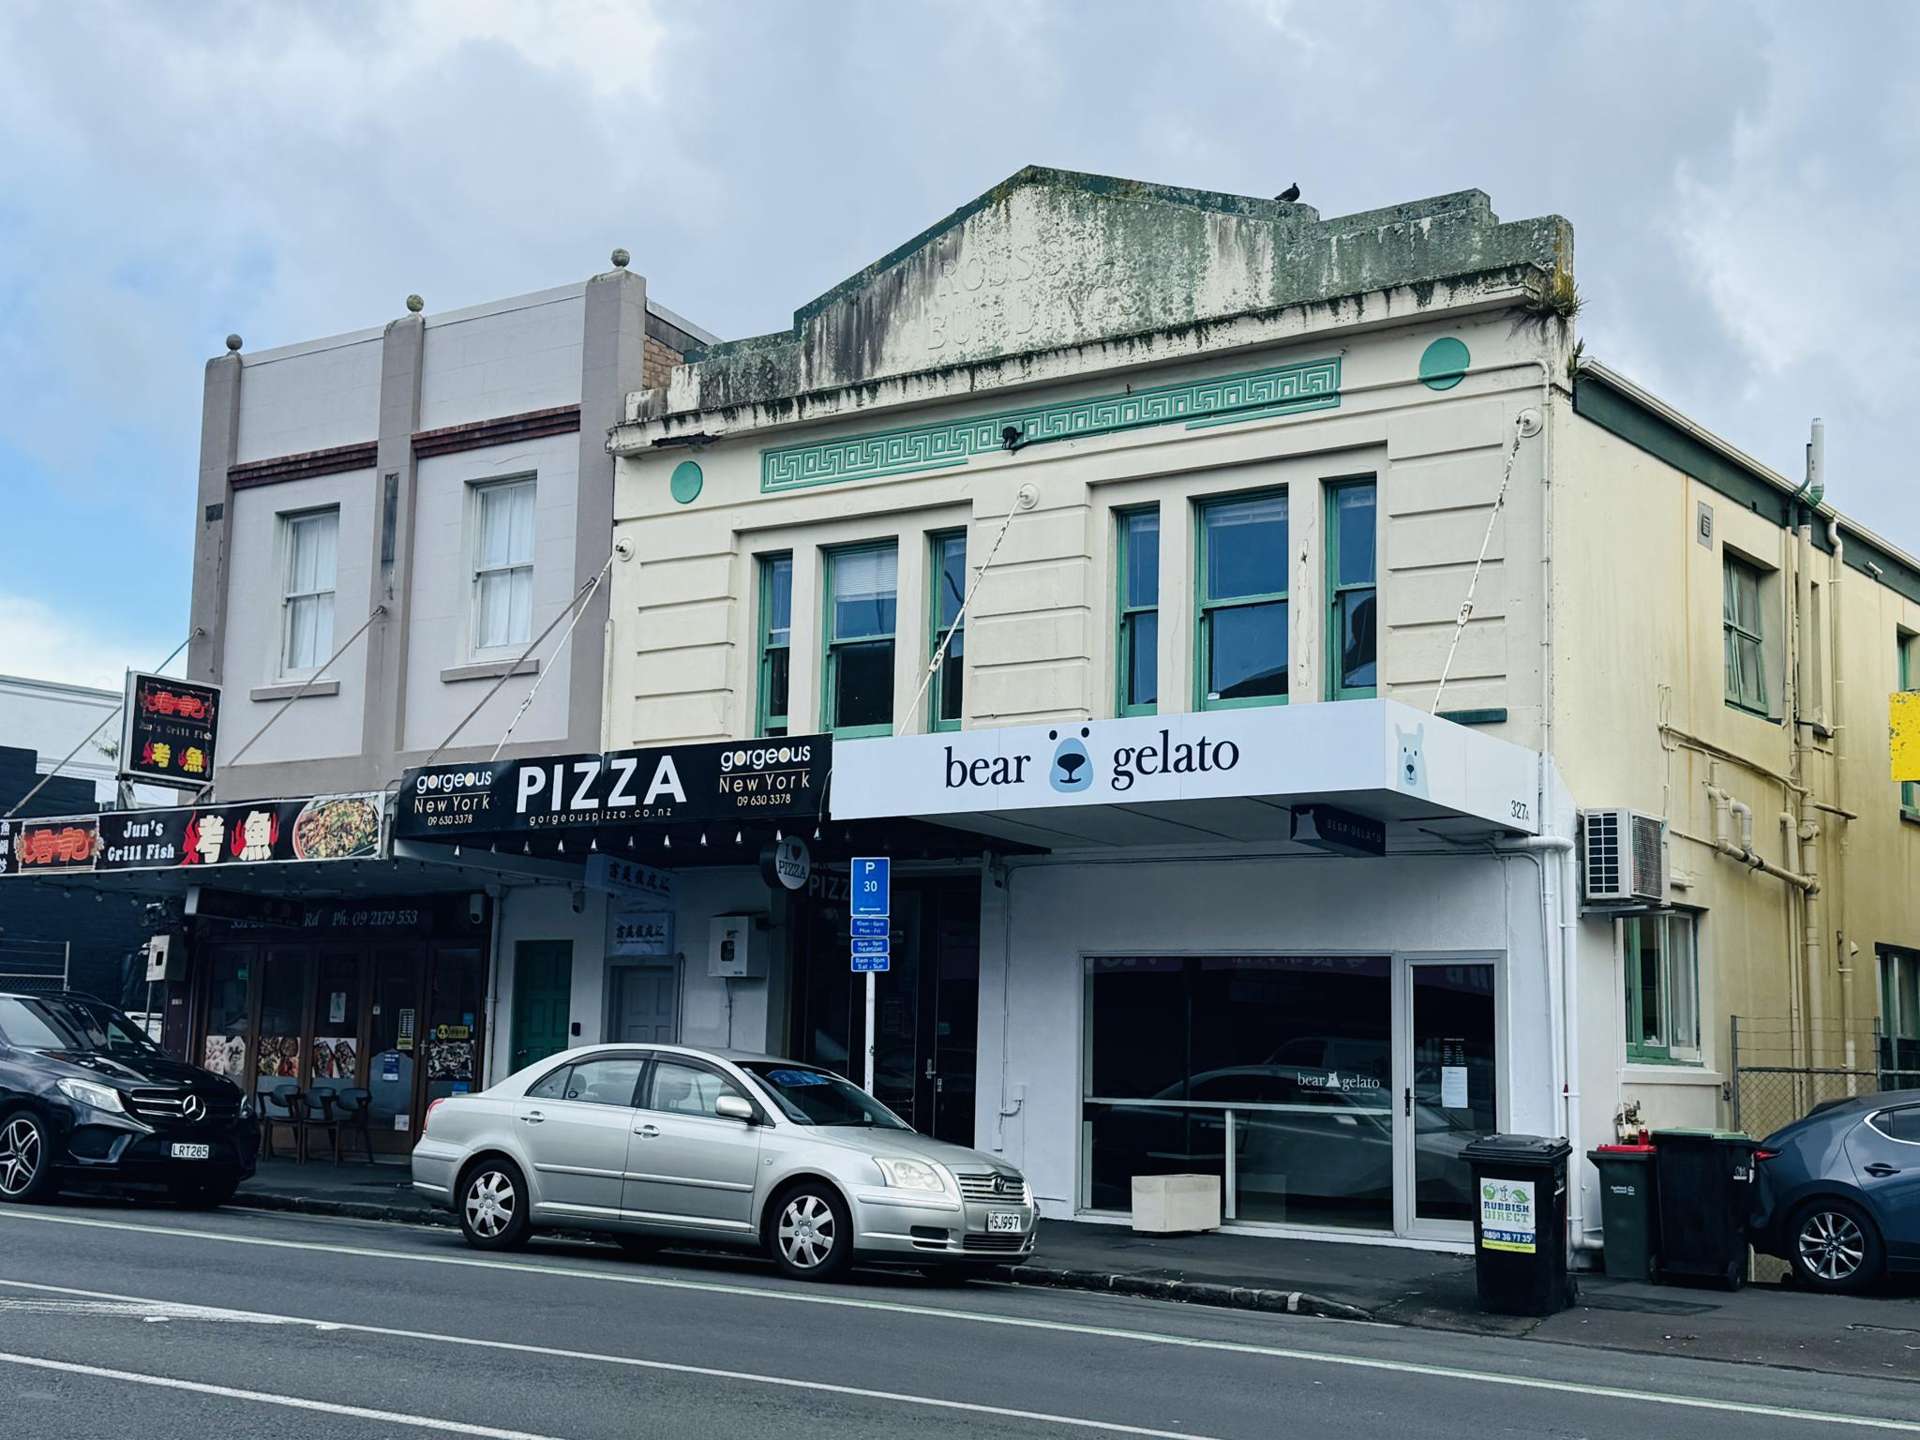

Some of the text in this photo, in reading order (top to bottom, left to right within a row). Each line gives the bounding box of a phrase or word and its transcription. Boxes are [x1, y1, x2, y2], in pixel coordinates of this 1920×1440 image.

[720, 744, 811, 772] gorgeous
[944, 729, 1240, 791] bear gelato
[416, 771, 492, 794] gorgeous
[516, 755, 687, 813] PIZZA
[719, 770, 810, 793] New York
[414, 794, 490, 814] New York
[736, 793, 791, 806] 09 630 3378
[427, 814, 473, 826] 09 630 3378
[529, 807, 672, 826] gorgeouspizza.co.nz
[123, 820, 164, 838] Jun's
[107, 843, 175, 862] Grill Fish
[778, 860, 806, 880] PIZZA
[865, 862, 876, 875] P
[808, 874, 850, 900] PIZZ
[863, 880, 878, 893] 30
[304, 911, 322, 928] Rd
[1297, 1072, 1380, 1092] bear gelato
[1483, 1201, 1529, 1213] RUBBISH
[1484, 1210, 1529, 1223] DIRECT
